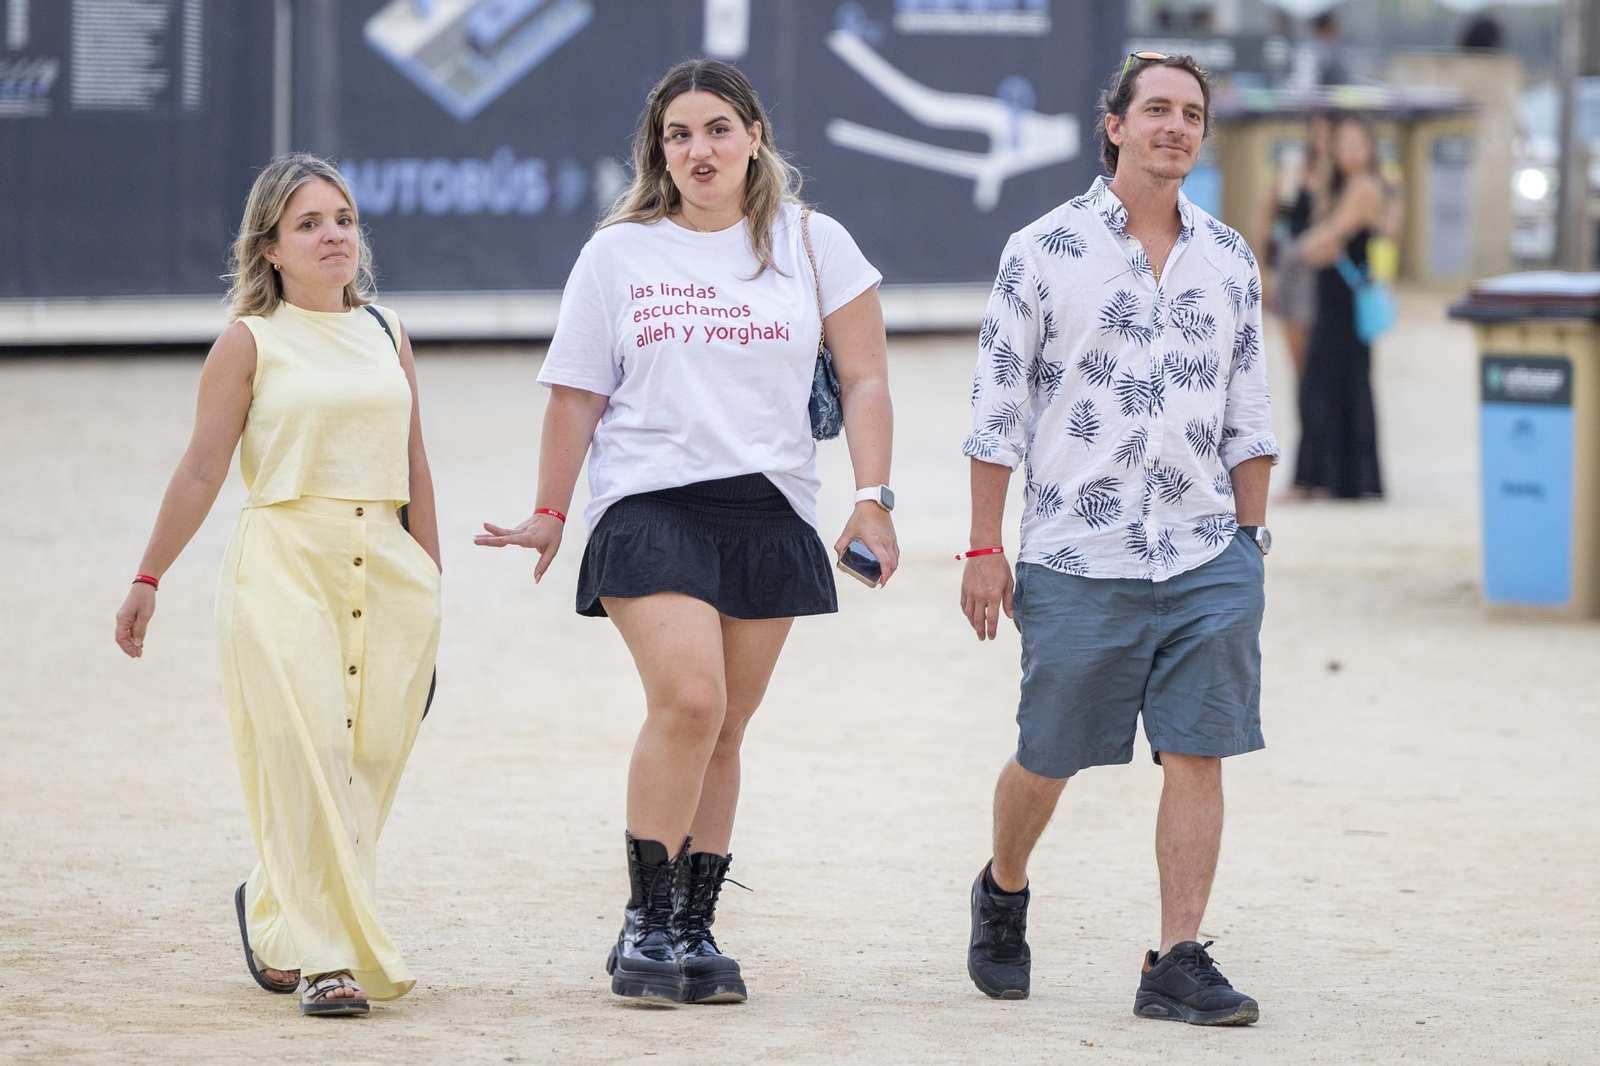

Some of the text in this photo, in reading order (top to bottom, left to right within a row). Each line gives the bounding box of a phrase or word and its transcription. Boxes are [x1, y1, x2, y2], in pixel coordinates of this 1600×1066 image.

[630, 283, 717, 301] las lindas
[633, 301, 751, 323] escuchamos
[636, 321, 790, 348] alleh y yorghaki
